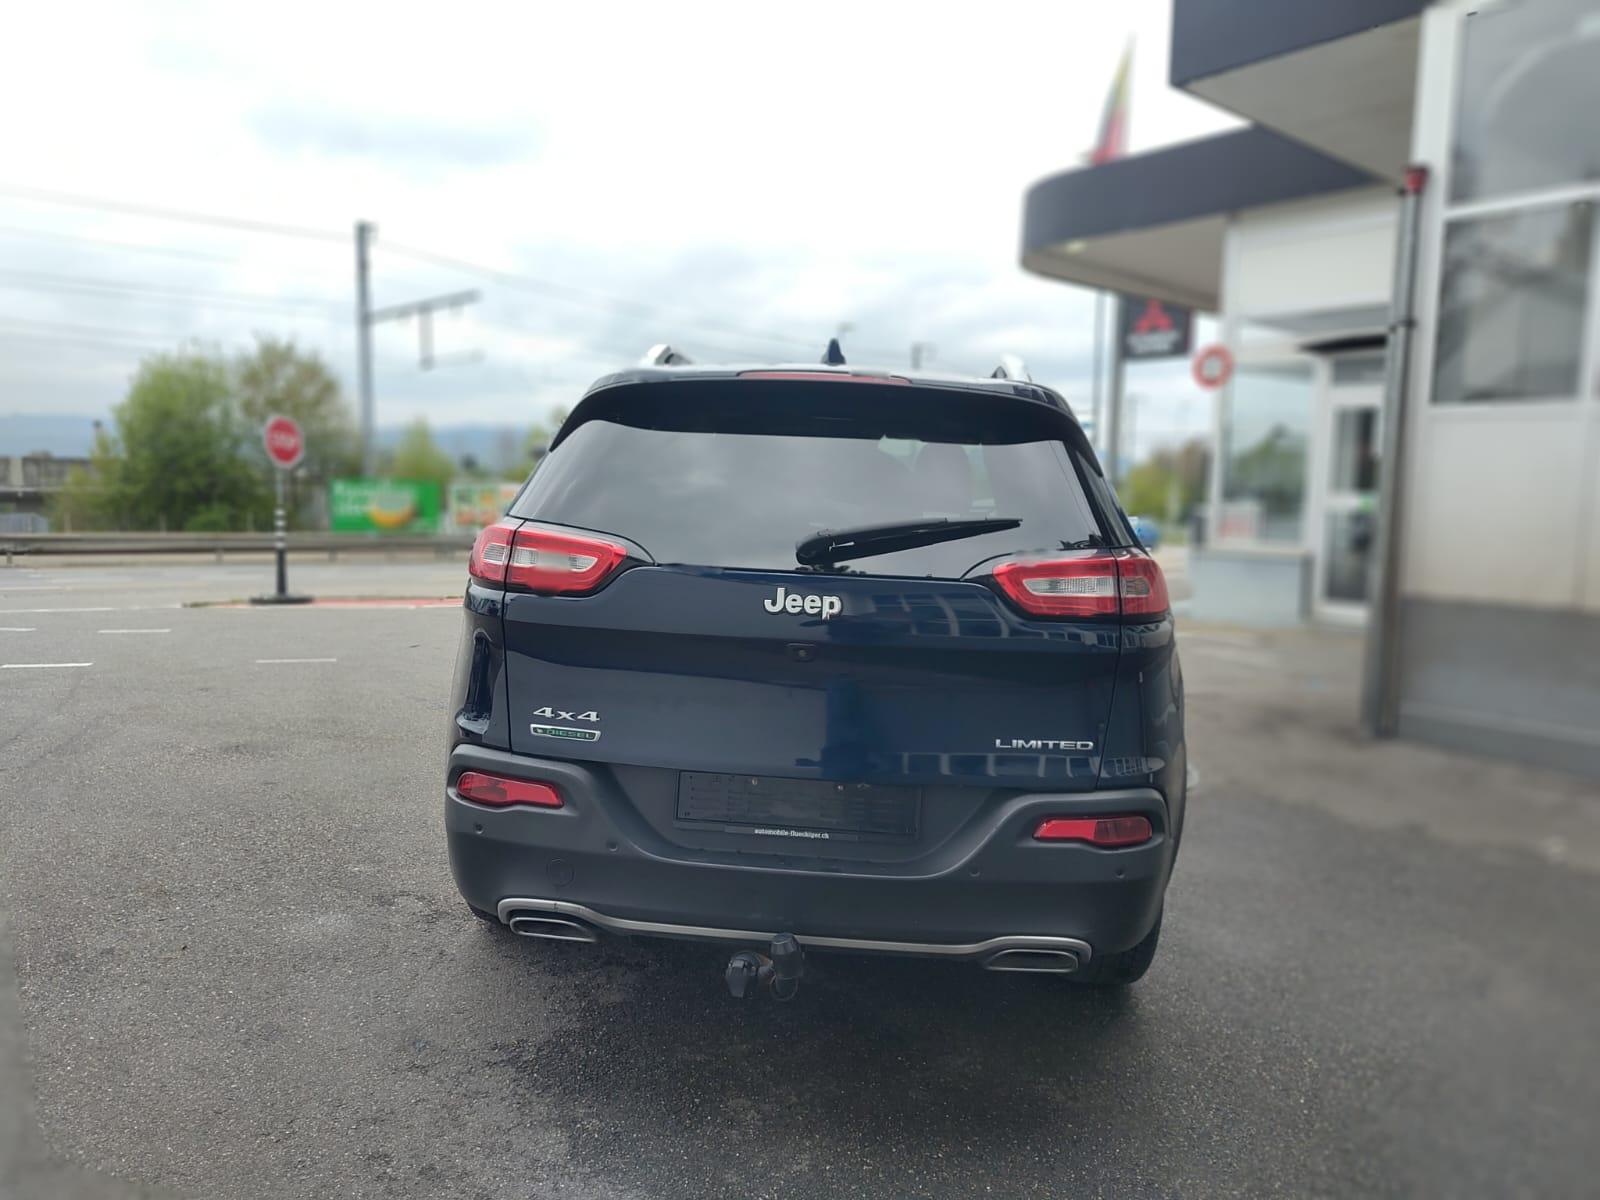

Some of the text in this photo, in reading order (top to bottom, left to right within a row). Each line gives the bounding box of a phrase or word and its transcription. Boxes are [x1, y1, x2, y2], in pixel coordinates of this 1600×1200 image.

[764, 587, 842, 620] Jeep
[532, 706, 600, 722] 4x4
[995, 738, 1094, 750] LIMITED
